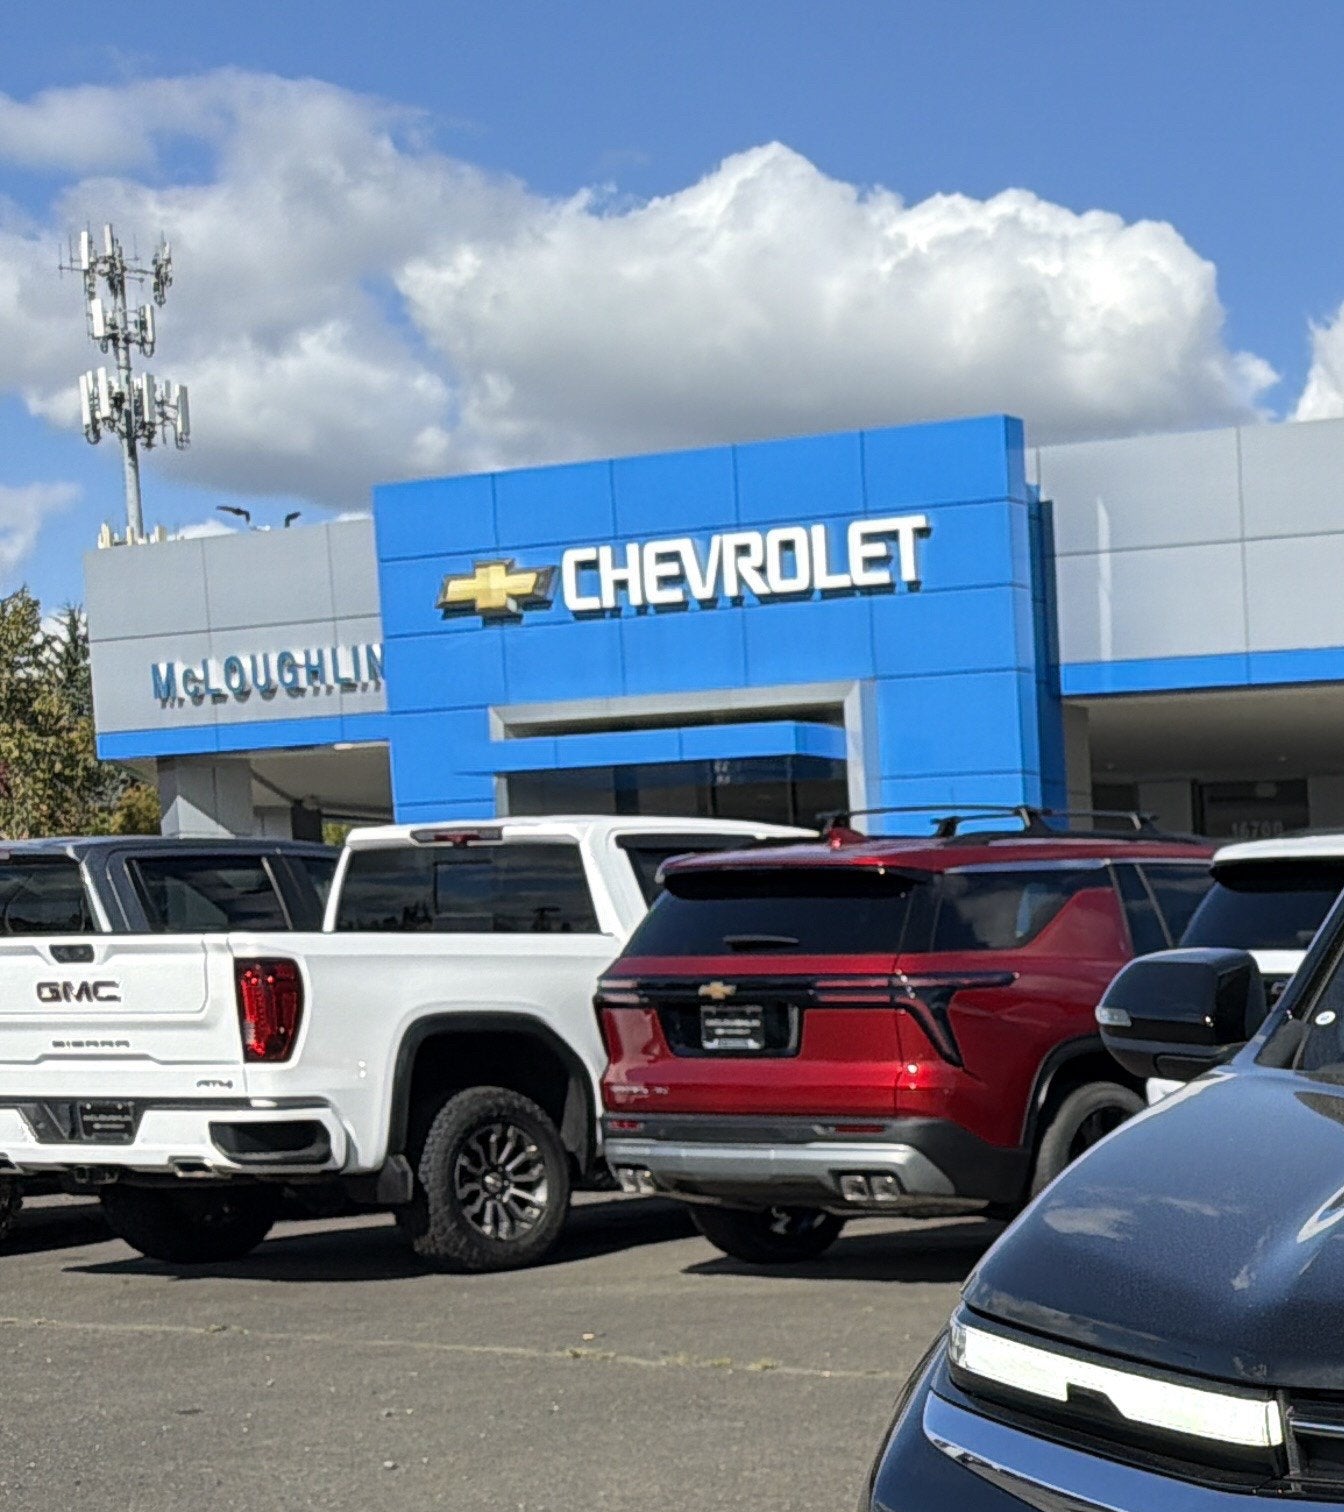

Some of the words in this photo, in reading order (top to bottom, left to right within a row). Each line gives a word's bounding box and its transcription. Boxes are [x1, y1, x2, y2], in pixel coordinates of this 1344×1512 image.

[562, 514, 927, 612] CHEVROLET
[151, 643, 385, 700] McLOUGHLIN
[36, 981, 122, 1002] GMC
